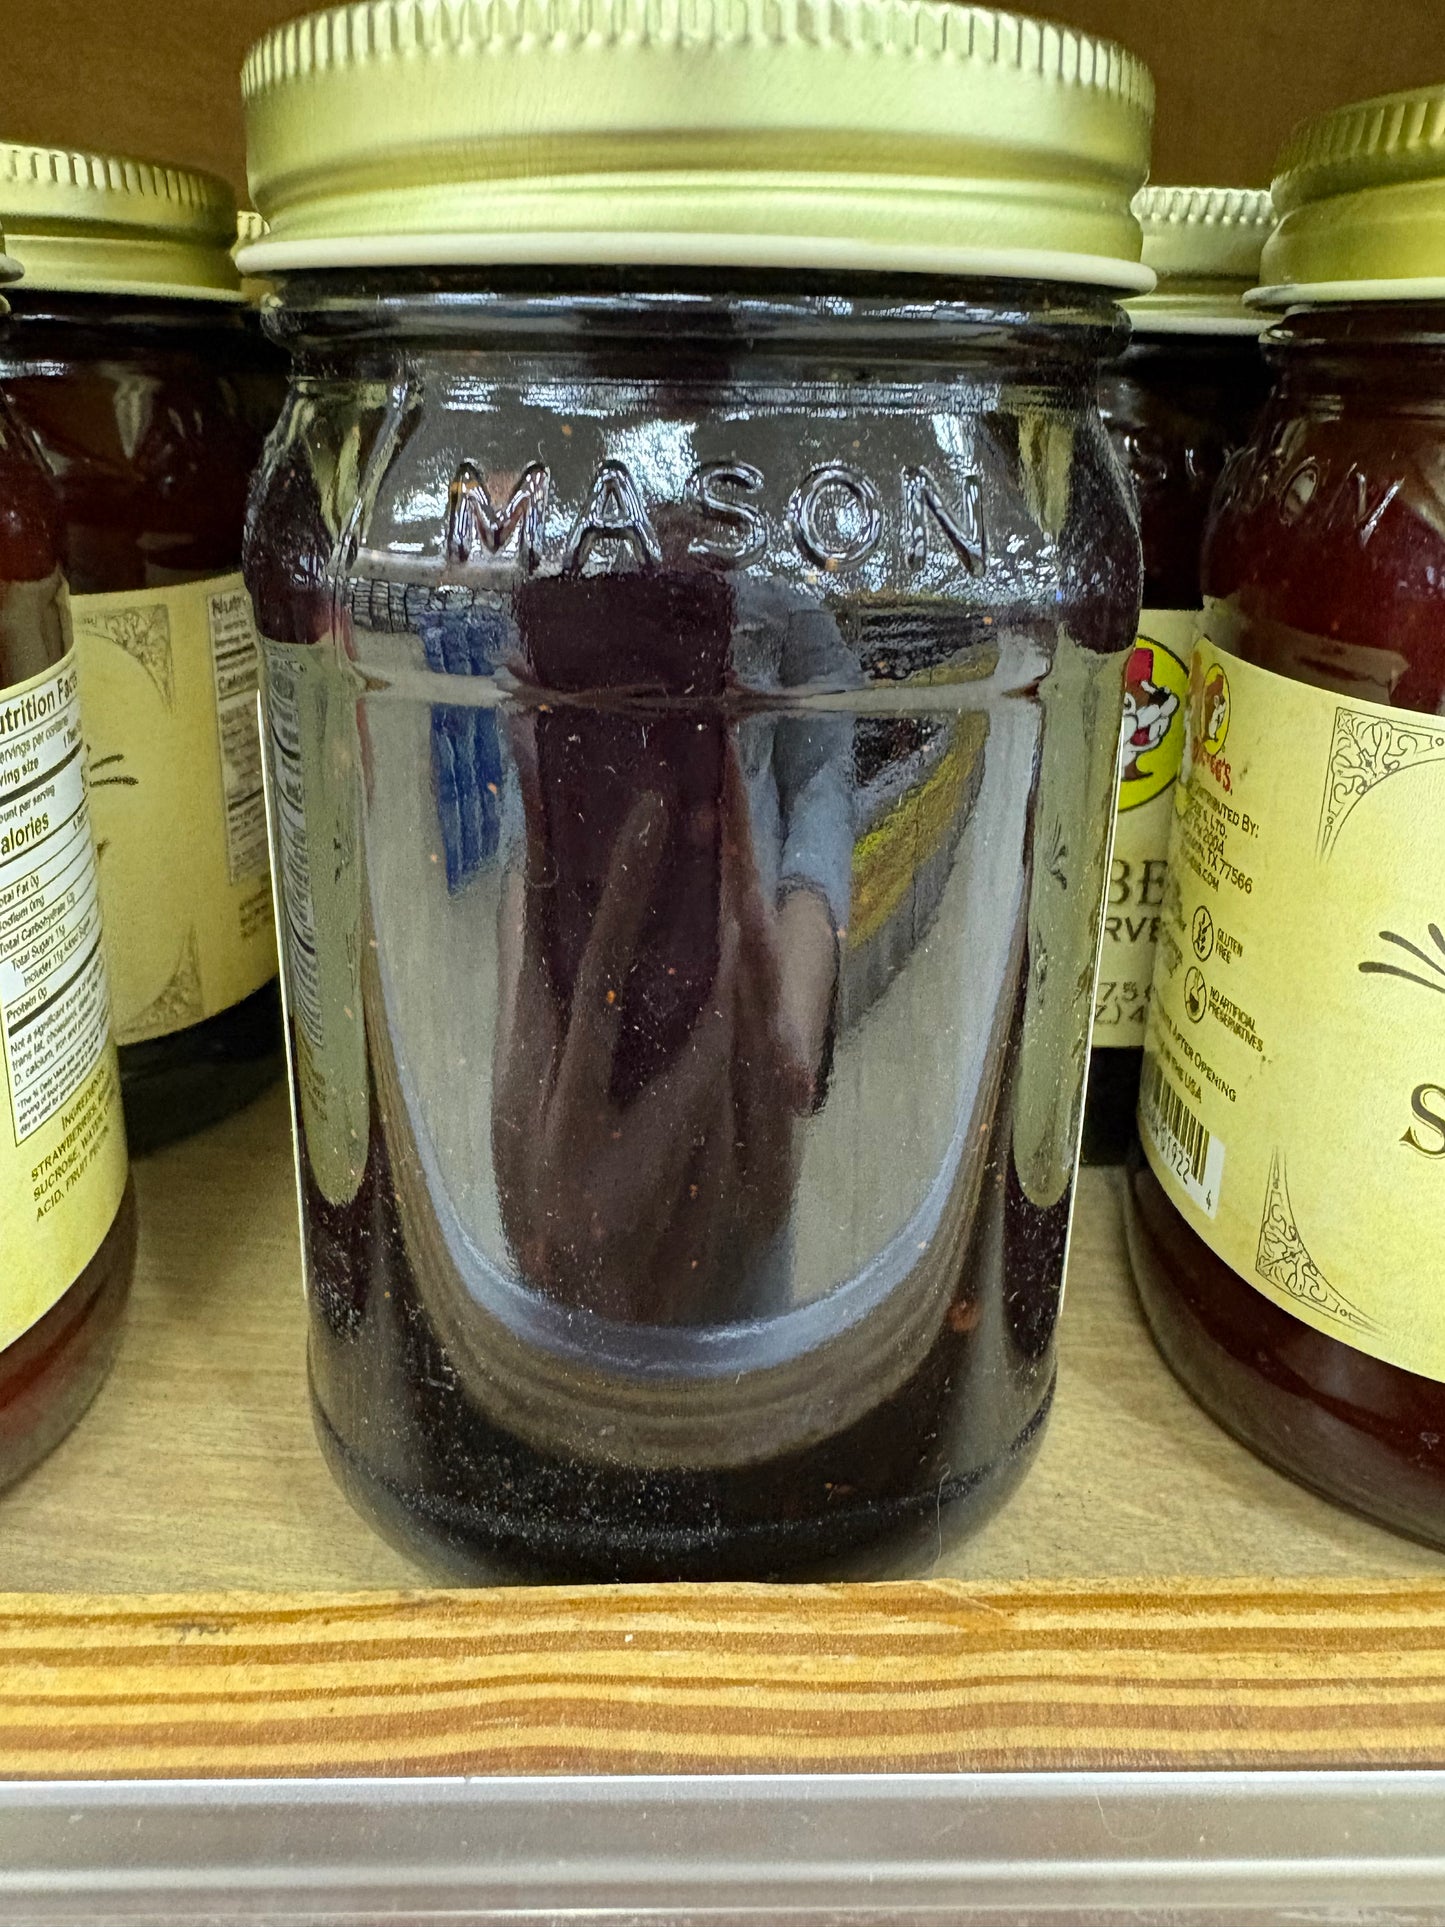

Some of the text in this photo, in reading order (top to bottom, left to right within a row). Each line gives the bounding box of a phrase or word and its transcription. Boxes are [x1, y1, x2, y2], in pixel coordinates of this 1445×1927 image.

[445, 458, 990, 578] MASON
[1, 812, 49, 856] alories
[1219, 857, 1253, 894] 77566
[1215, 940, 1231, 965] FREE
[1217, 927, 1243, 957] GLUTEN
[11, 950, 31, 972] Total
[6, 995, 37, 1024] Protein
[1210, 986, 1220, 1002] NO
[1208, 1000, 1263, 1053] PRESERVATIVES
[1194, 1052, 1237, 1103] OPENING
